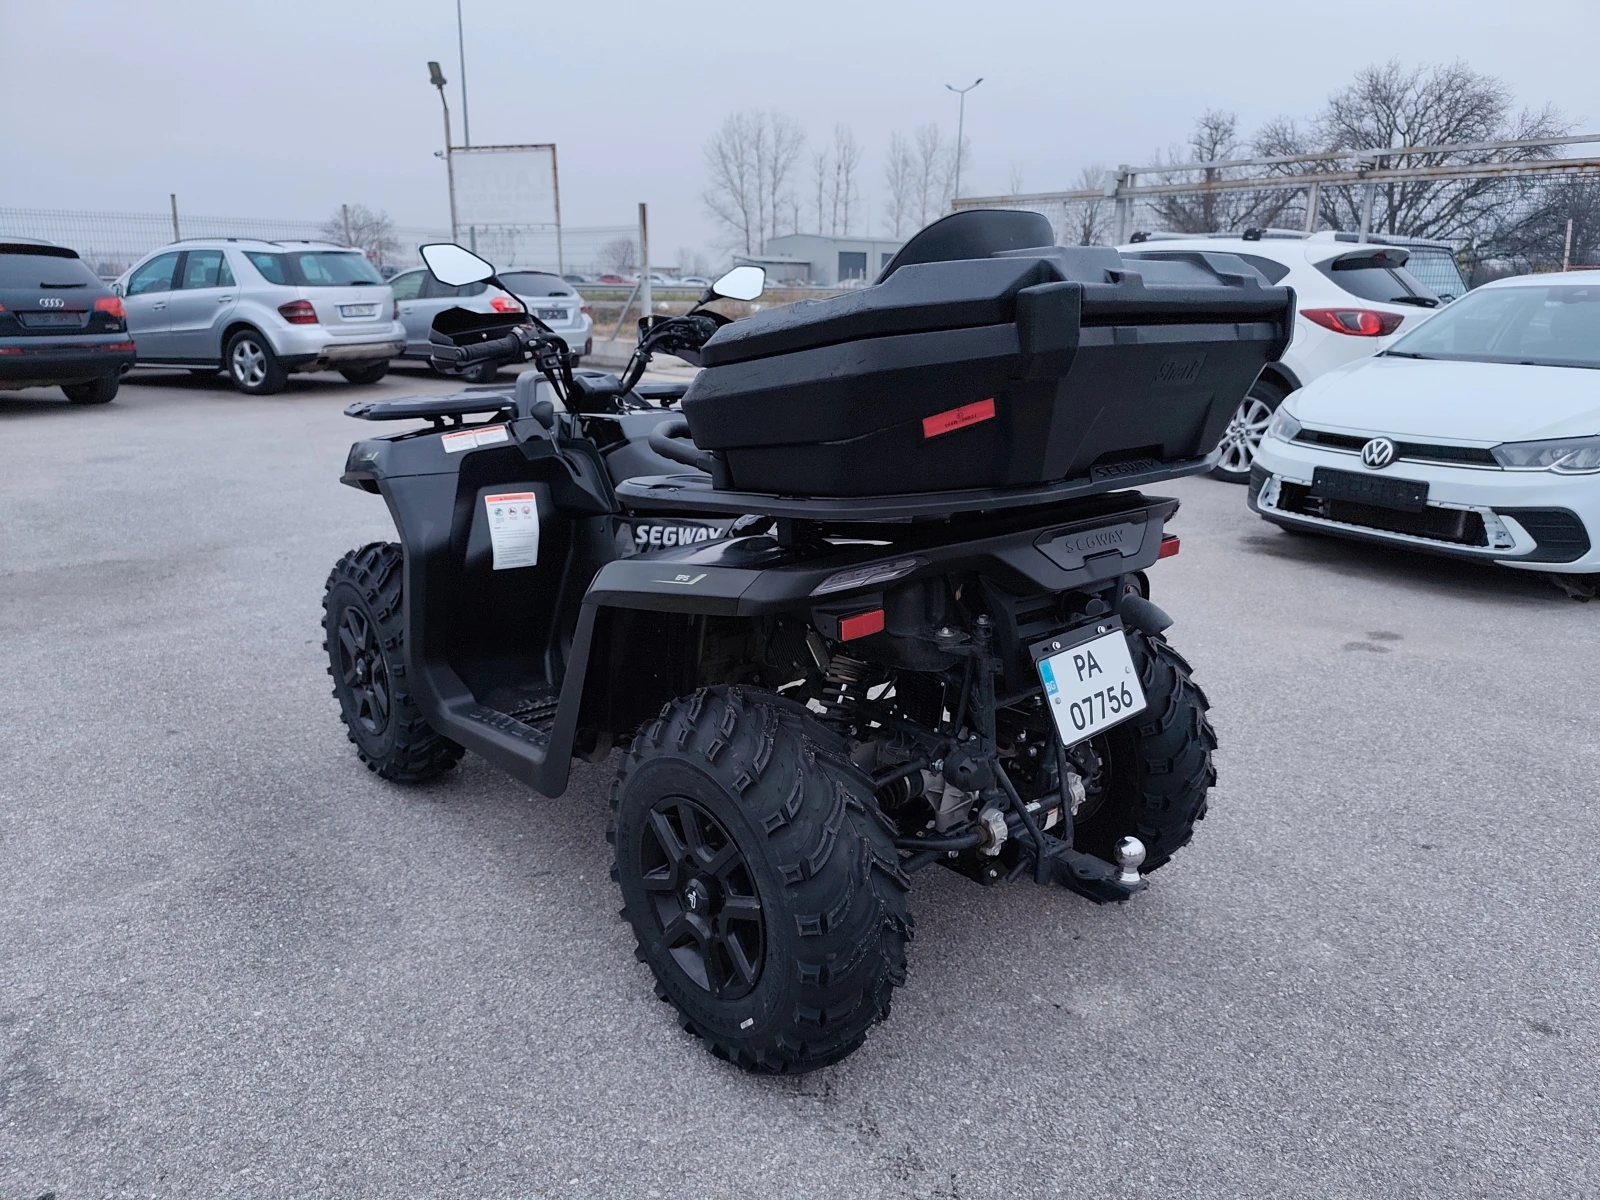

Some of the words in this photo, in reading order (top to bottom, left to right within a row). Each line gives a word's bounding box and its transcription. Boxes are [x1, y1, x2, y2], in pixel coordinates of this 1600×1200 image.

[1066, 529, 1124, 553] SEGWAY
[1072, 650, 1103, 682] PA
[1069, 681, 1133, 731] 07756
